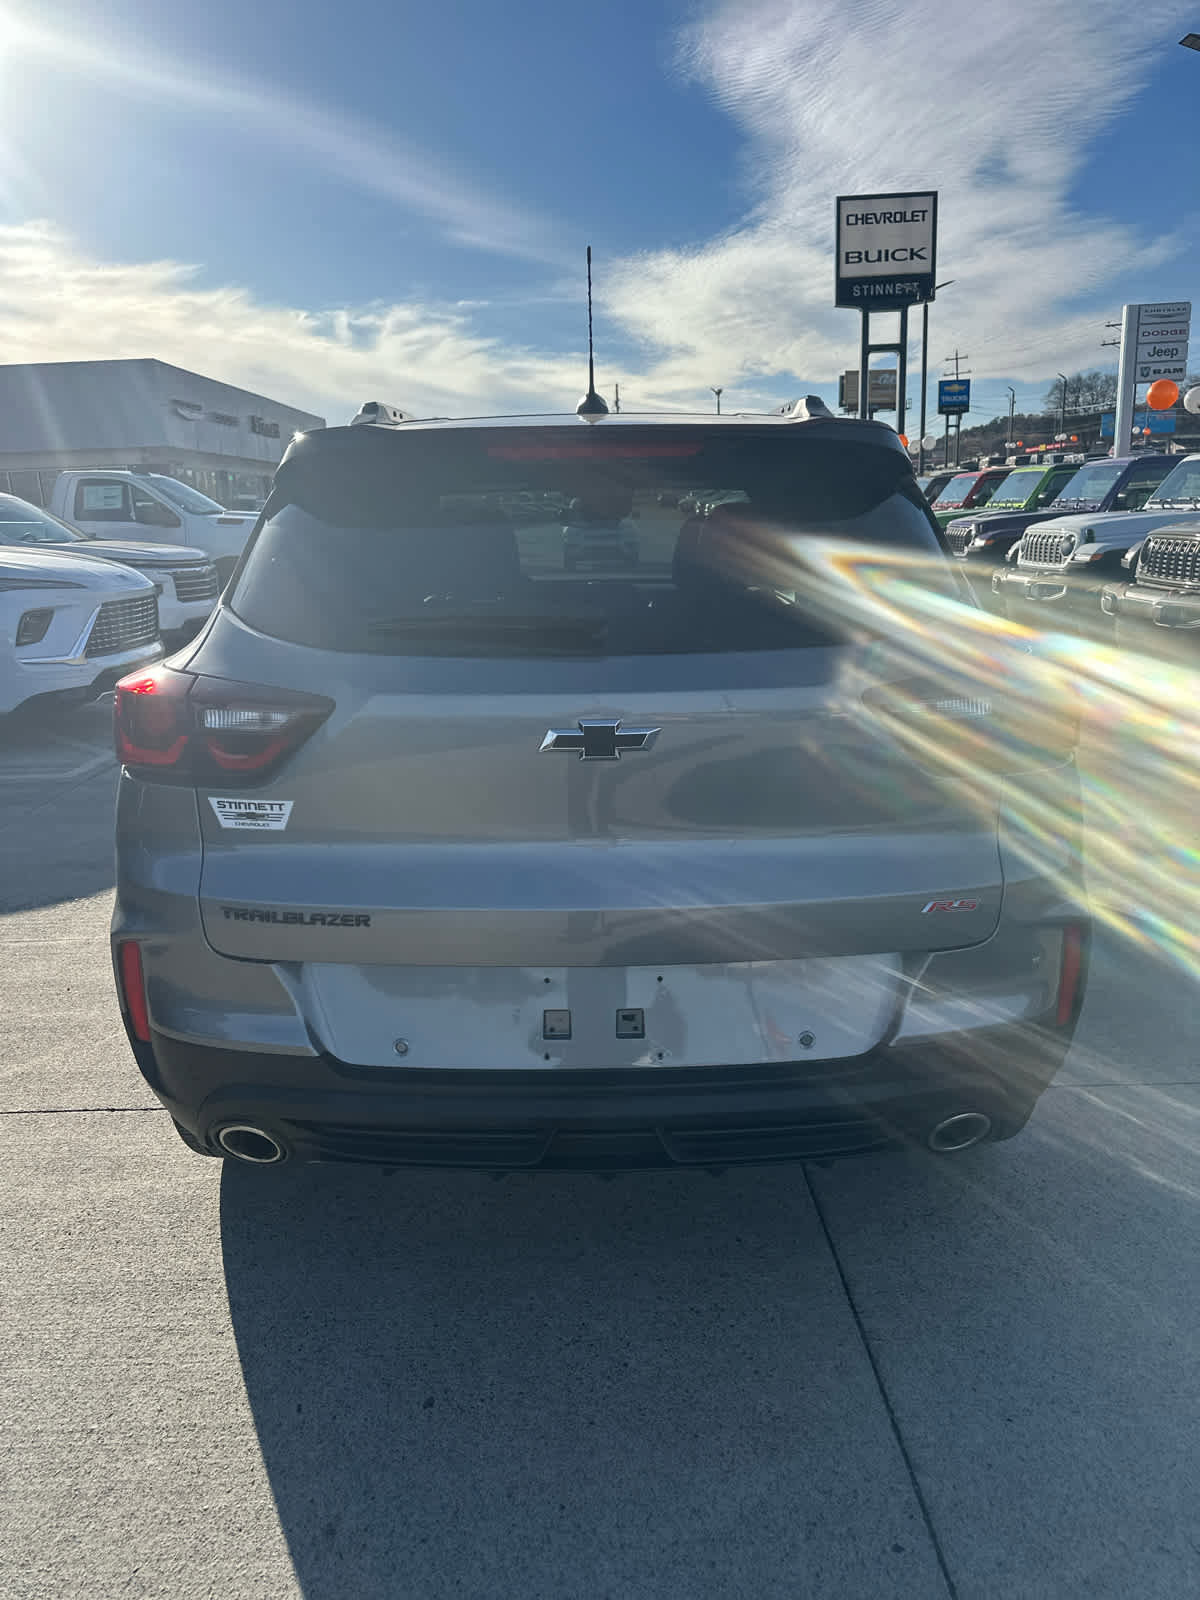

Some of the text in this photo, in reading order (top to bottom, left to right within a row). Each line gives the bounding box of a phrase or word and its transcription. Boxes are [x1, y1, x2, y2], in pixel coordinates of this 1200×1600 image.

[846, 210, 928, 226] CHEVROLET
[845, 247, 927, 264] BUICK
[1147, 345, 1178, 358] Jeep
[216, 800, 285, 812] STINNETT
[221, 906, 371, 928] TRAILBLAZER
